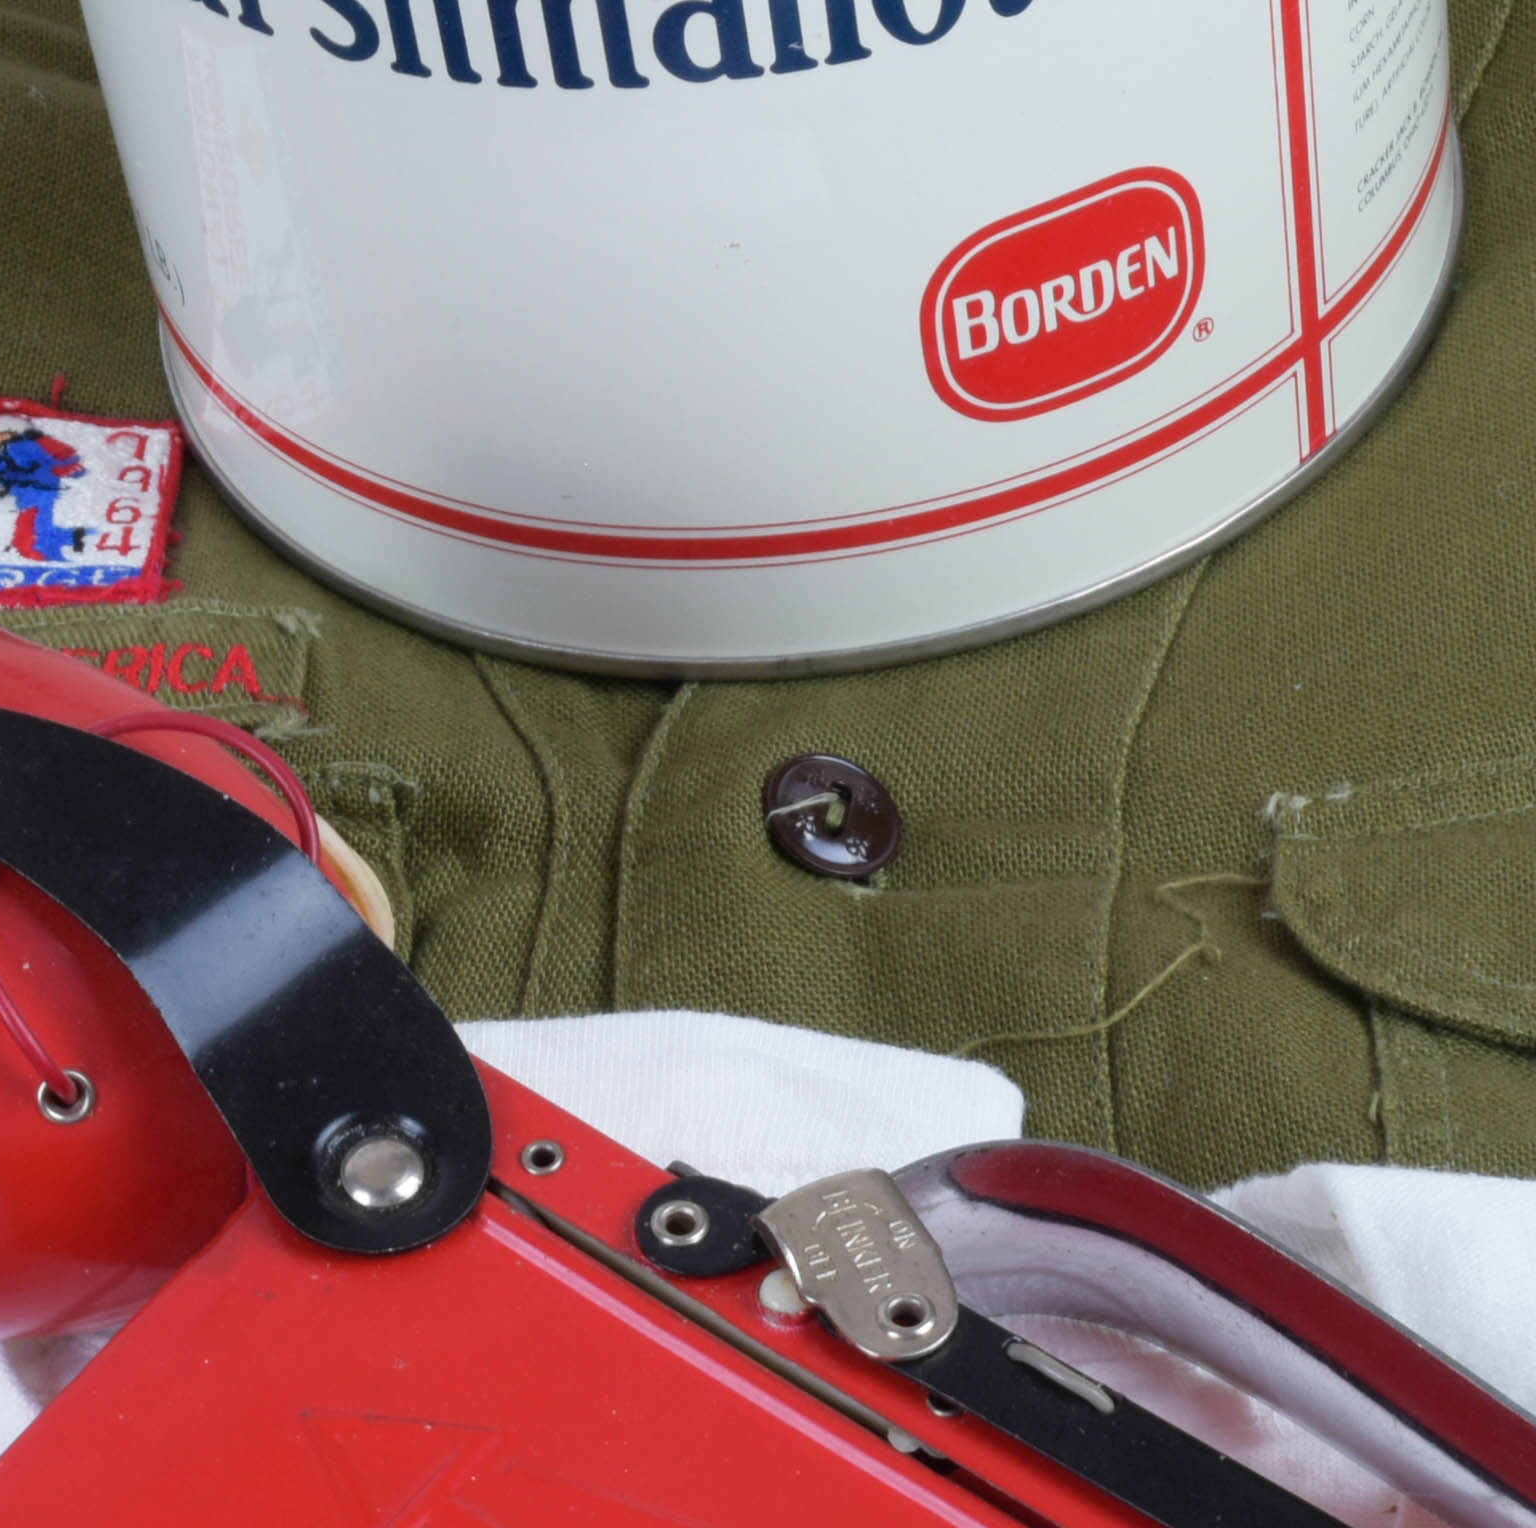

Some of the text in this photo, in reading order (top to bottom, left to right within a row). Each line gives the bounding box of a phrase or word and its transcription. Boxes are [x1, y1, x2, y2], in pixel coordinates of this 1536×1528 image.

[952, 226, 1180, 360] BORDEN
[64, 643, 263, 695] RICA
[822, 1189, 893, 1295] BLINKER
